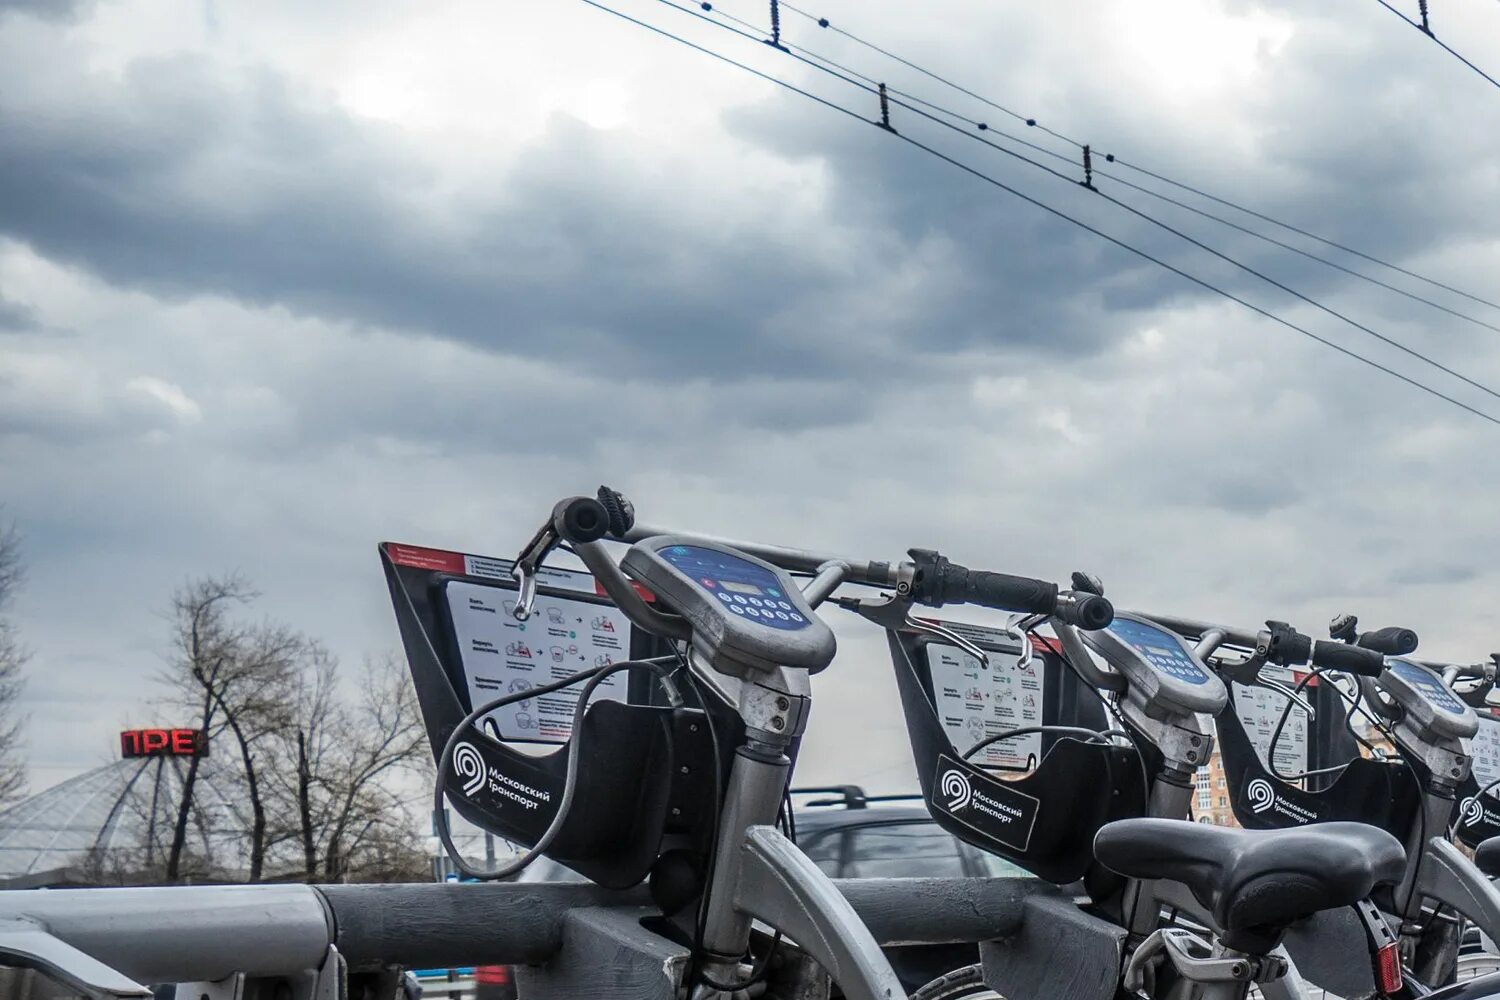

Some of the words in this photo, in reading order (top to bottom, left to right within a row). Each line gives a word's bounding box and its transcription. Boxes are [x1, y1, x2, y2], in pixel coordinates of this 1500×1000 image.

[487, 778, 539, 810] Транспорт
[488, 766, 551, 803] Московский
[971, 798, 1013, 824] Транспорт
[972, 789, 1022, 818] Московский
[1274, 802, 1309, 824] Транспорт
[1275, 794, 1318, 820] Московский
